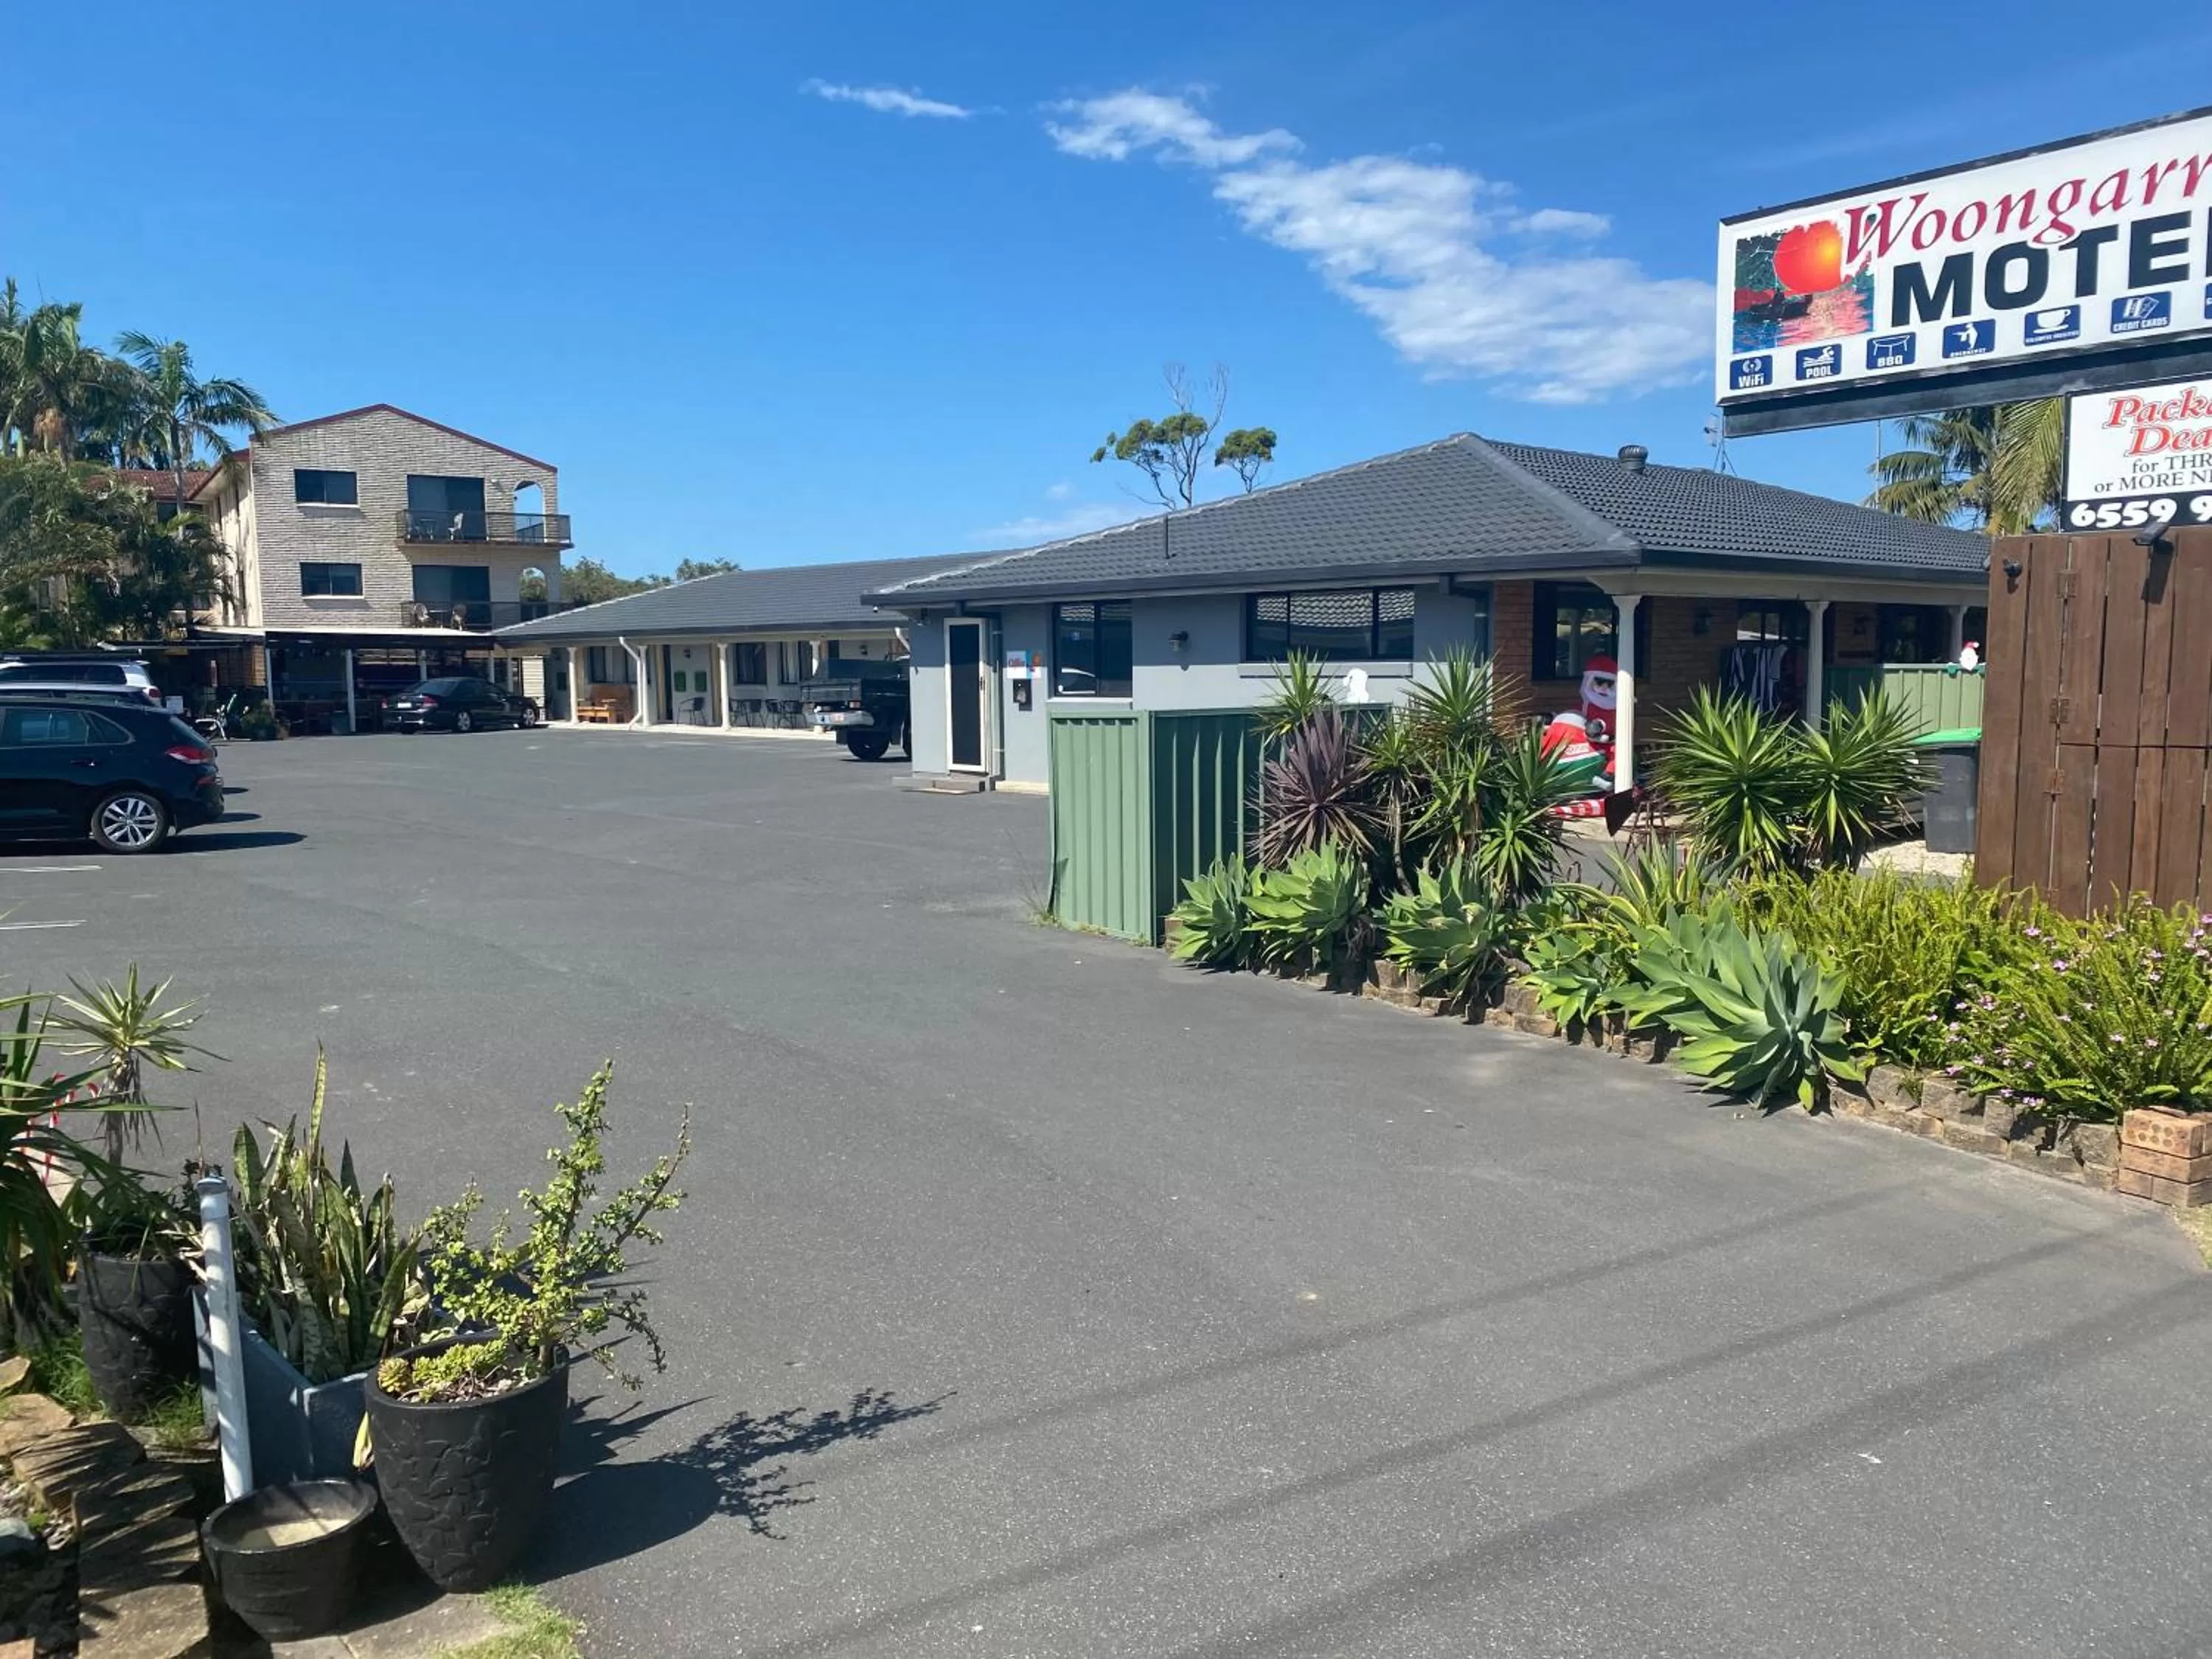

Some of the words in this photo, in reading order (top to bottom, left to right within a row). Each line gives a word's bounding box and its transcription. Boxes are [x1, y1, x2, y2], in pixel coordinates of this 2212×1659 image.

[1891, 206, 2212, 327] MOTE
[1738, 373, 1764, 388] WiFi
[1806, 366, 1833, 378] POOL
[2132, 458, 2159, 473] for
[2094, 481, 2113, 493] or
[2118, 472, 2184, 491] MORE
[2070, 498, 2177, 529] 6559
[2190, 495, 2212, 522] 9
